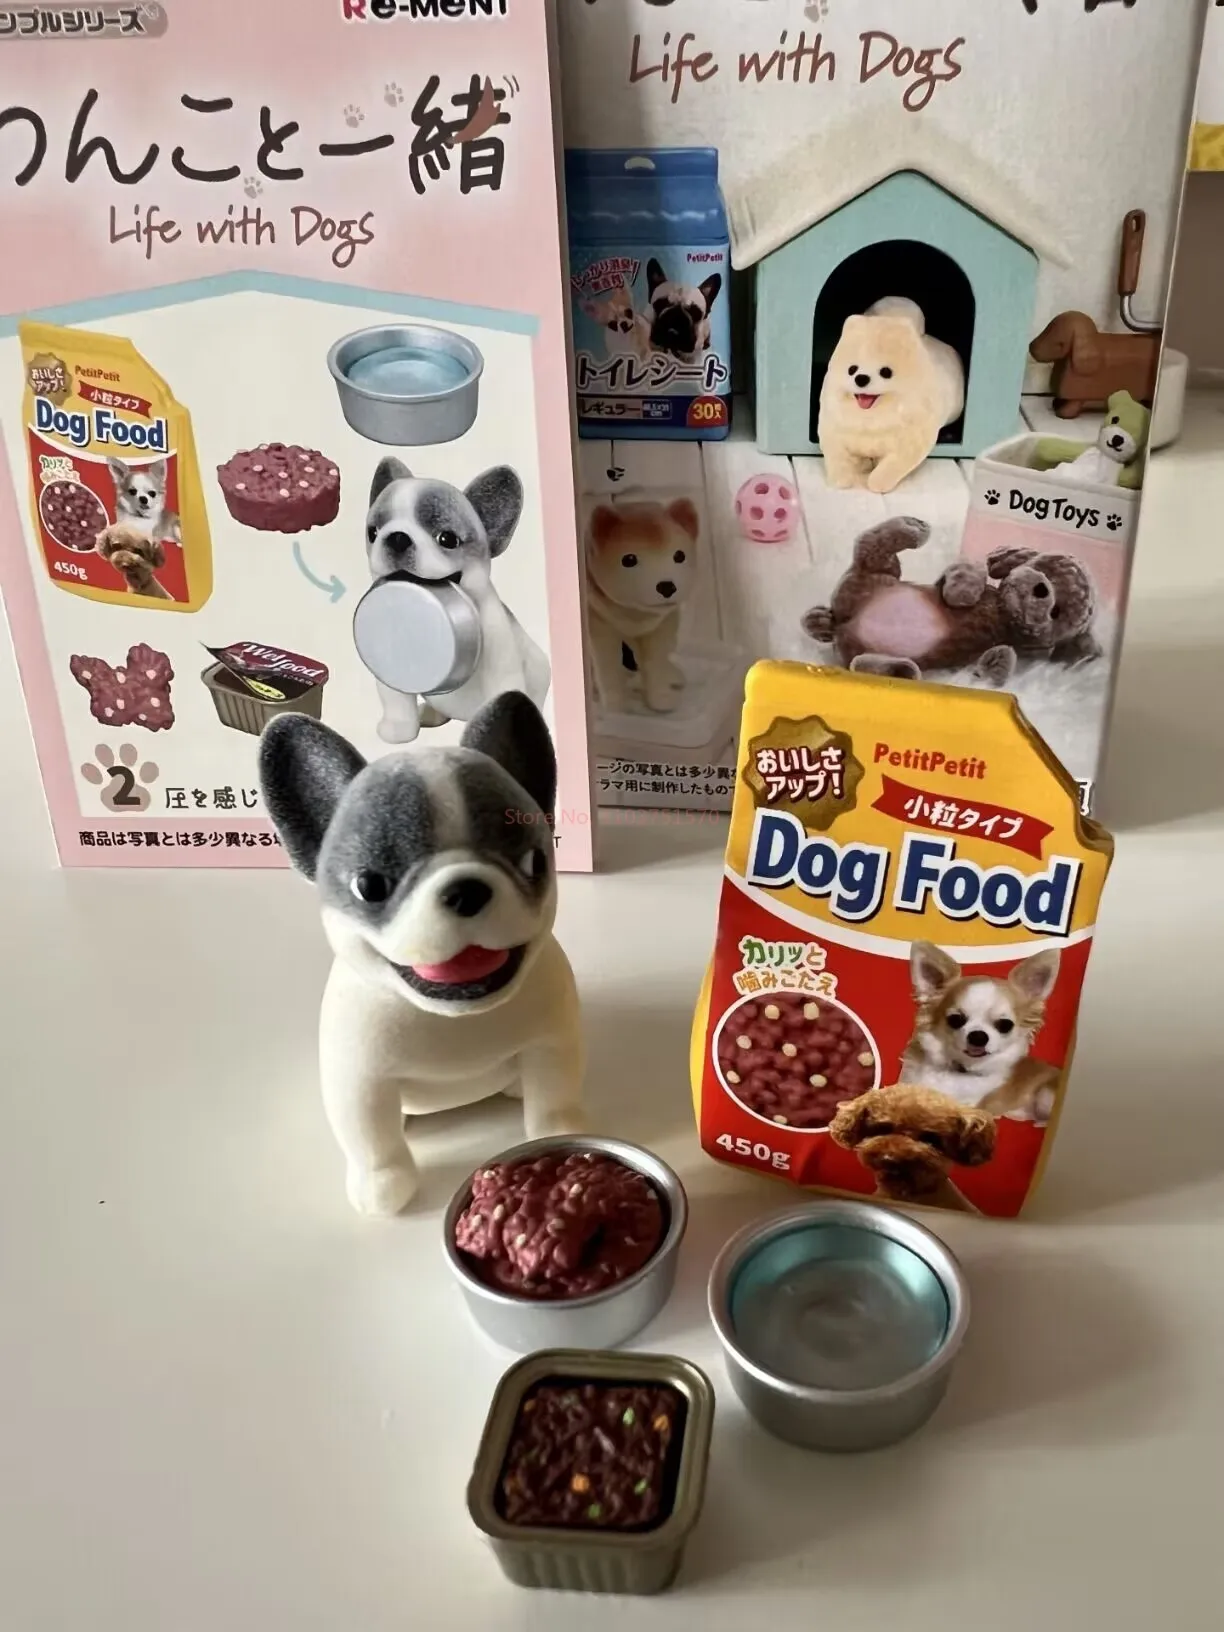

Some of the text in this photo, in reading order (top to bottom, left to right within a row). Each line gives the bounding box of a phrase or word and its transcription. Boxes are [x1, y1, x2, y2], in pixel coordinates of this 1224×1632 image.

[630, 30, 966, 112] Life with Dogs
[109, 203, 375, 268] Life with Dogs
[75, 365, 121, 382] PetitPetit
[578, 355, 726, 389] トイレシート
[35, 396, 169, 454] Dog Food
[1009, 489, 1101, 529] Dog Toys
[53, 561, 88, 580] 450g
[756, 747, 843, 774] おいしさ
[873, 742, 987, 780] PetitPetit
[107, 765, 141, 806] 2
[165, 785, 258, 809] 圧を感じ
[597, 778, 735, 796] ラマ用に制作したもの
[766, 771, 841, 800] アップ!
[903, 794, 1024, 839] 小粒タイプ
[78, 831, 283, 847] 商品は写真とは多少異なる
[747, 808, 1083, 937] Dog Food
[742, 938, 826, 968] カリッと
[715, 1133, 791, 1170] 450g
